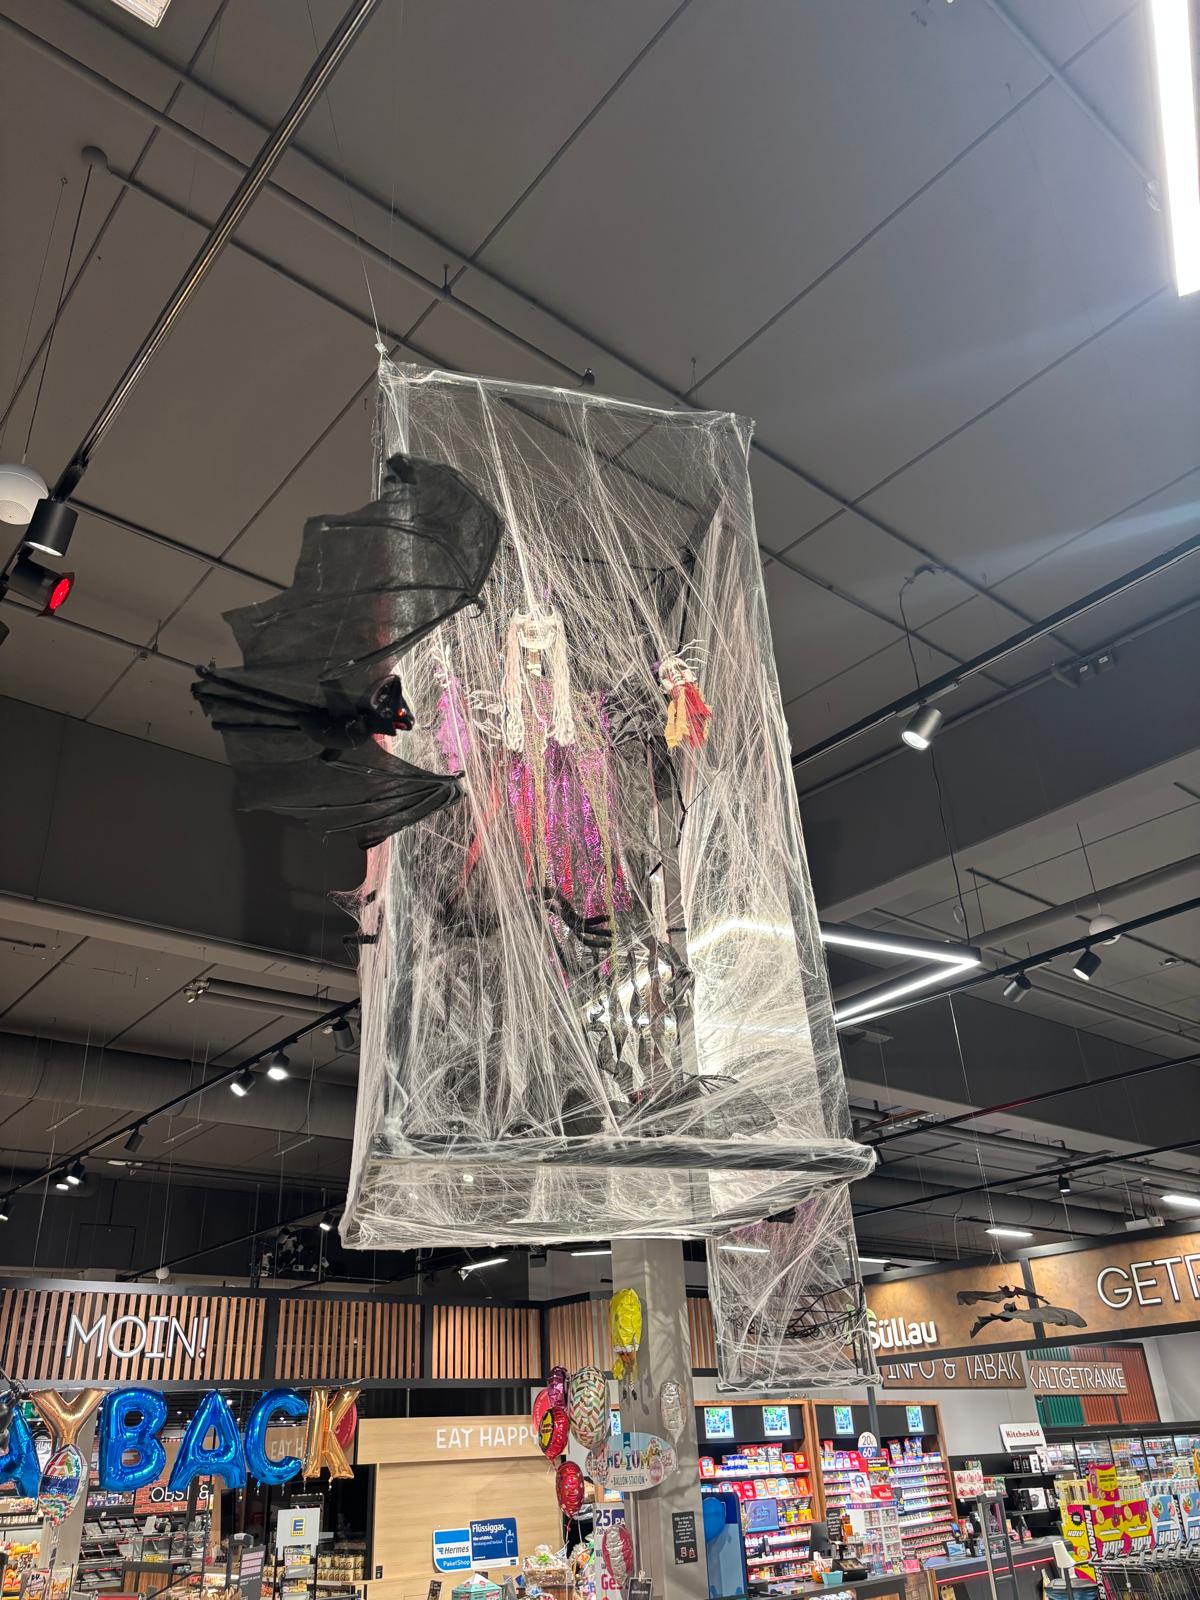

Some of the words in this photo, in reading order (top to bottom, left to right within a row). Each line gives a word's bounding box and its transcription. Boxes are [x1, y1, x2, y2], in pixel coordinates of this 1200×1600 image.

[65, 1314, 209, 1359] MOIN!
[868, 1317, 937, 1350] Süllau
[966, 1352, 1021, 1381] TABAK
[1030, 1364, 1126, 1389] KALTGETRÄNKE
[436, 1428, 473, 1449] EAT
[480, 1426, 539, 1447] HAPPY
[1005, 1430, 1040, 1439] KitchenAid
[596, 1509, 610, 1526] 25
[472, 1523, 506, 1534] Flüssiggas.
[444, 1545, 469, 1555] Hermes
[443, 1559, 470, 1567] PaketShop
